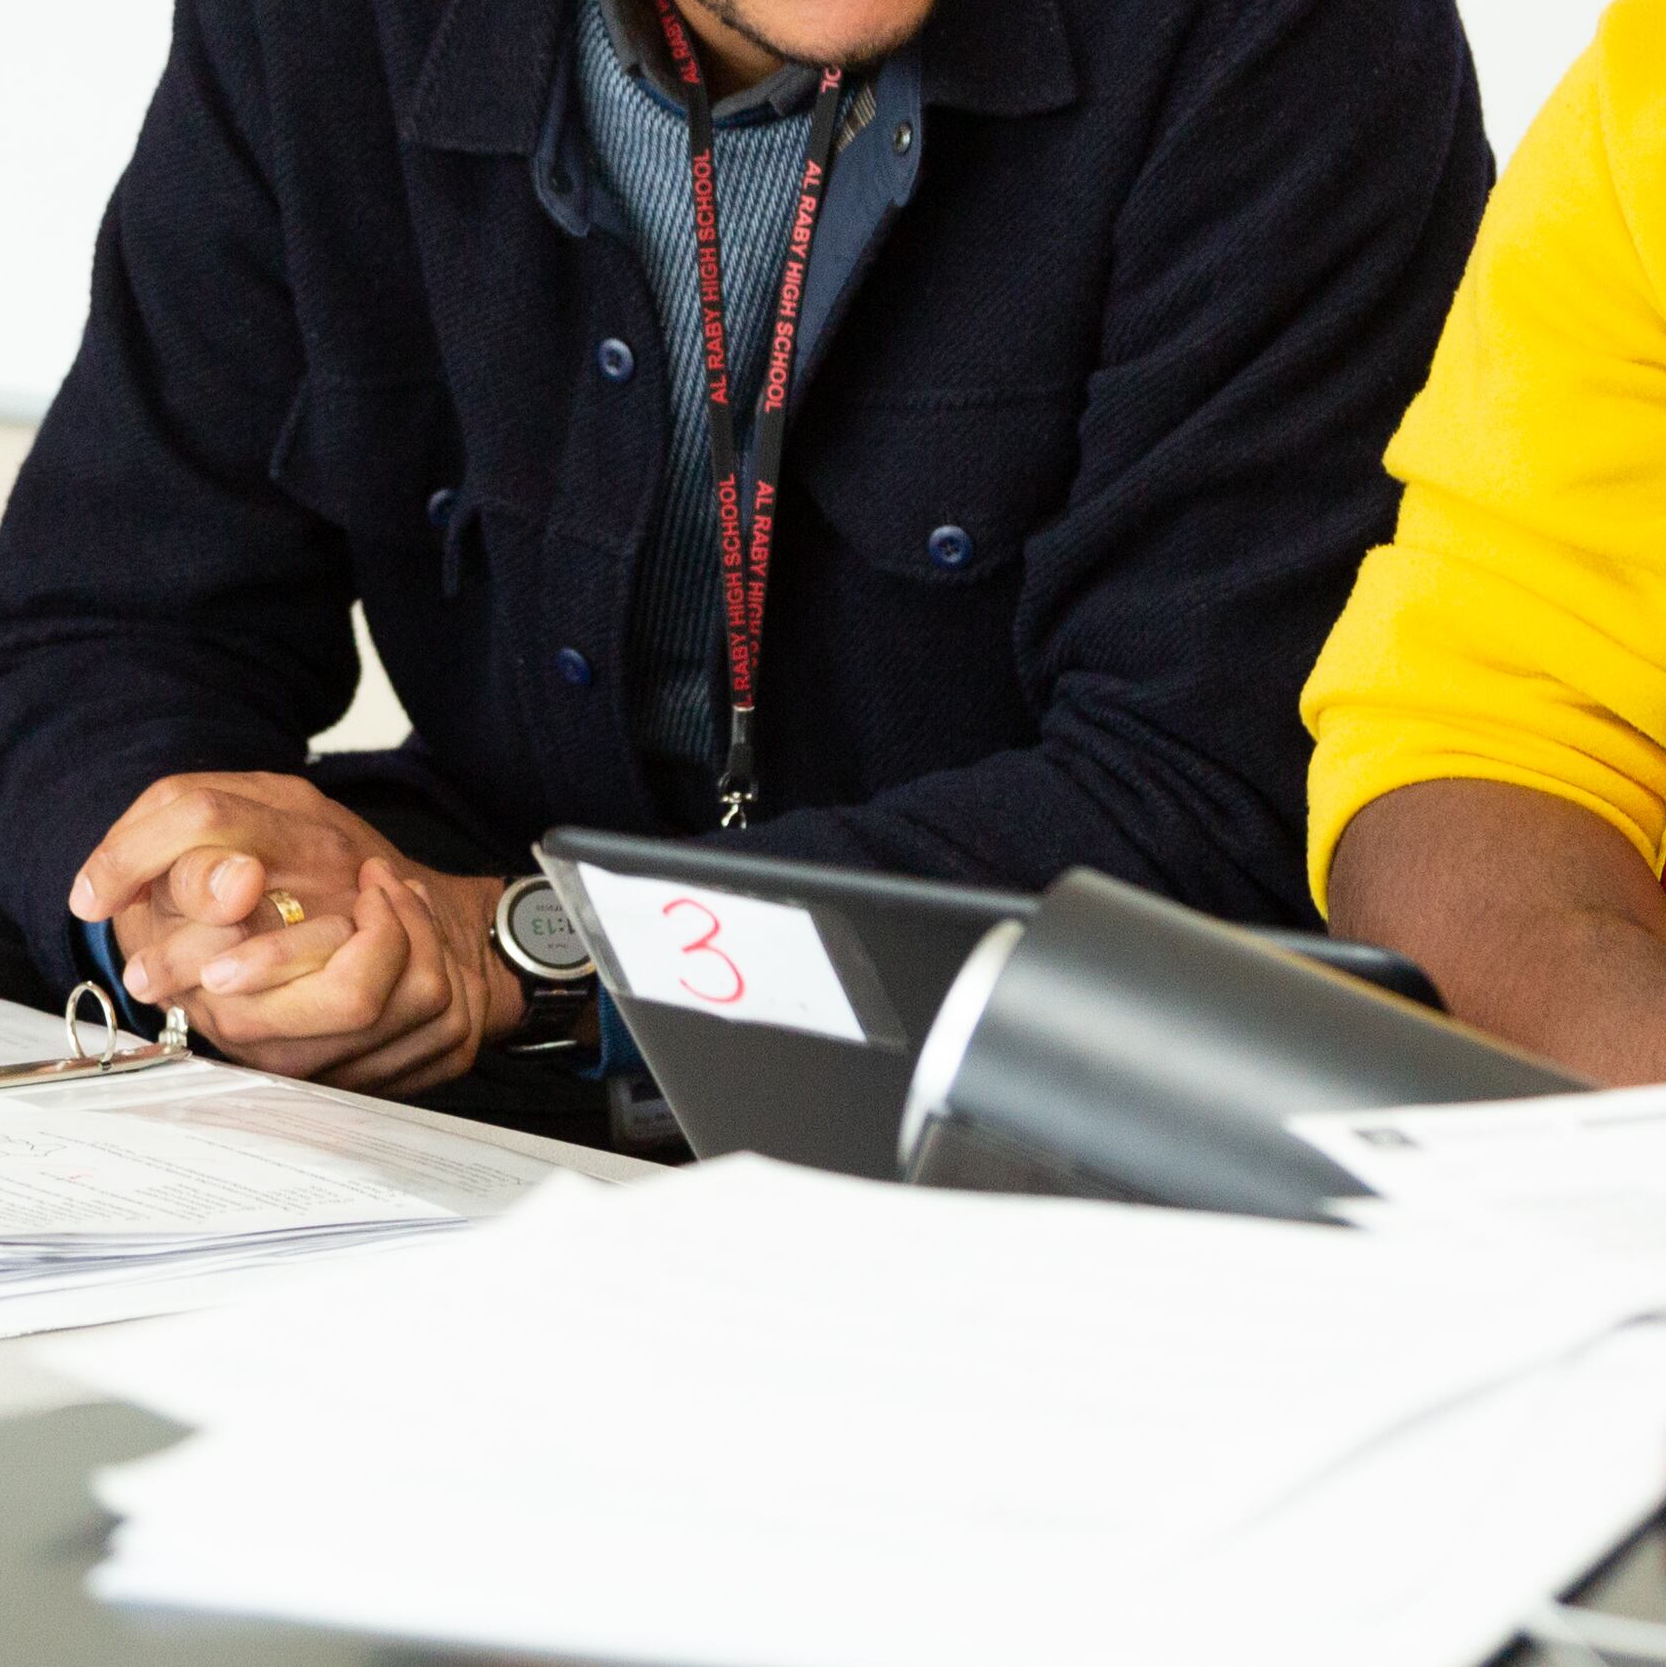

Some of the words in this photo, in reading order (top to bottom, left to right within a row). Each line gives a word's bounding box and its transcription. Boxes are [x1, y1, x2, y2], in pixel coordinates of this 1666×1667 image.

[693, 149, 716, 241] SCHOOL
[803, 160, 822, 190] AL
[791, 195, 817, 259] RABY
[699, 248, 719, 302] HIGH
[780, 260, 804, 317] HIGH
[703, 308, 725, 370] RABY
[764, 321, 794, 413] SCHOOL
[709, 374, 729, 405] AL
[717, 473, 742, 567] SCHOOL
[755, 480, 776, 510] AL
[749, 515, 773, 577] RABY
[724, 573, 746, 626] HIGH
[731, 633, 751, 691] RABY
[661, 897, 746, 1004] 3
